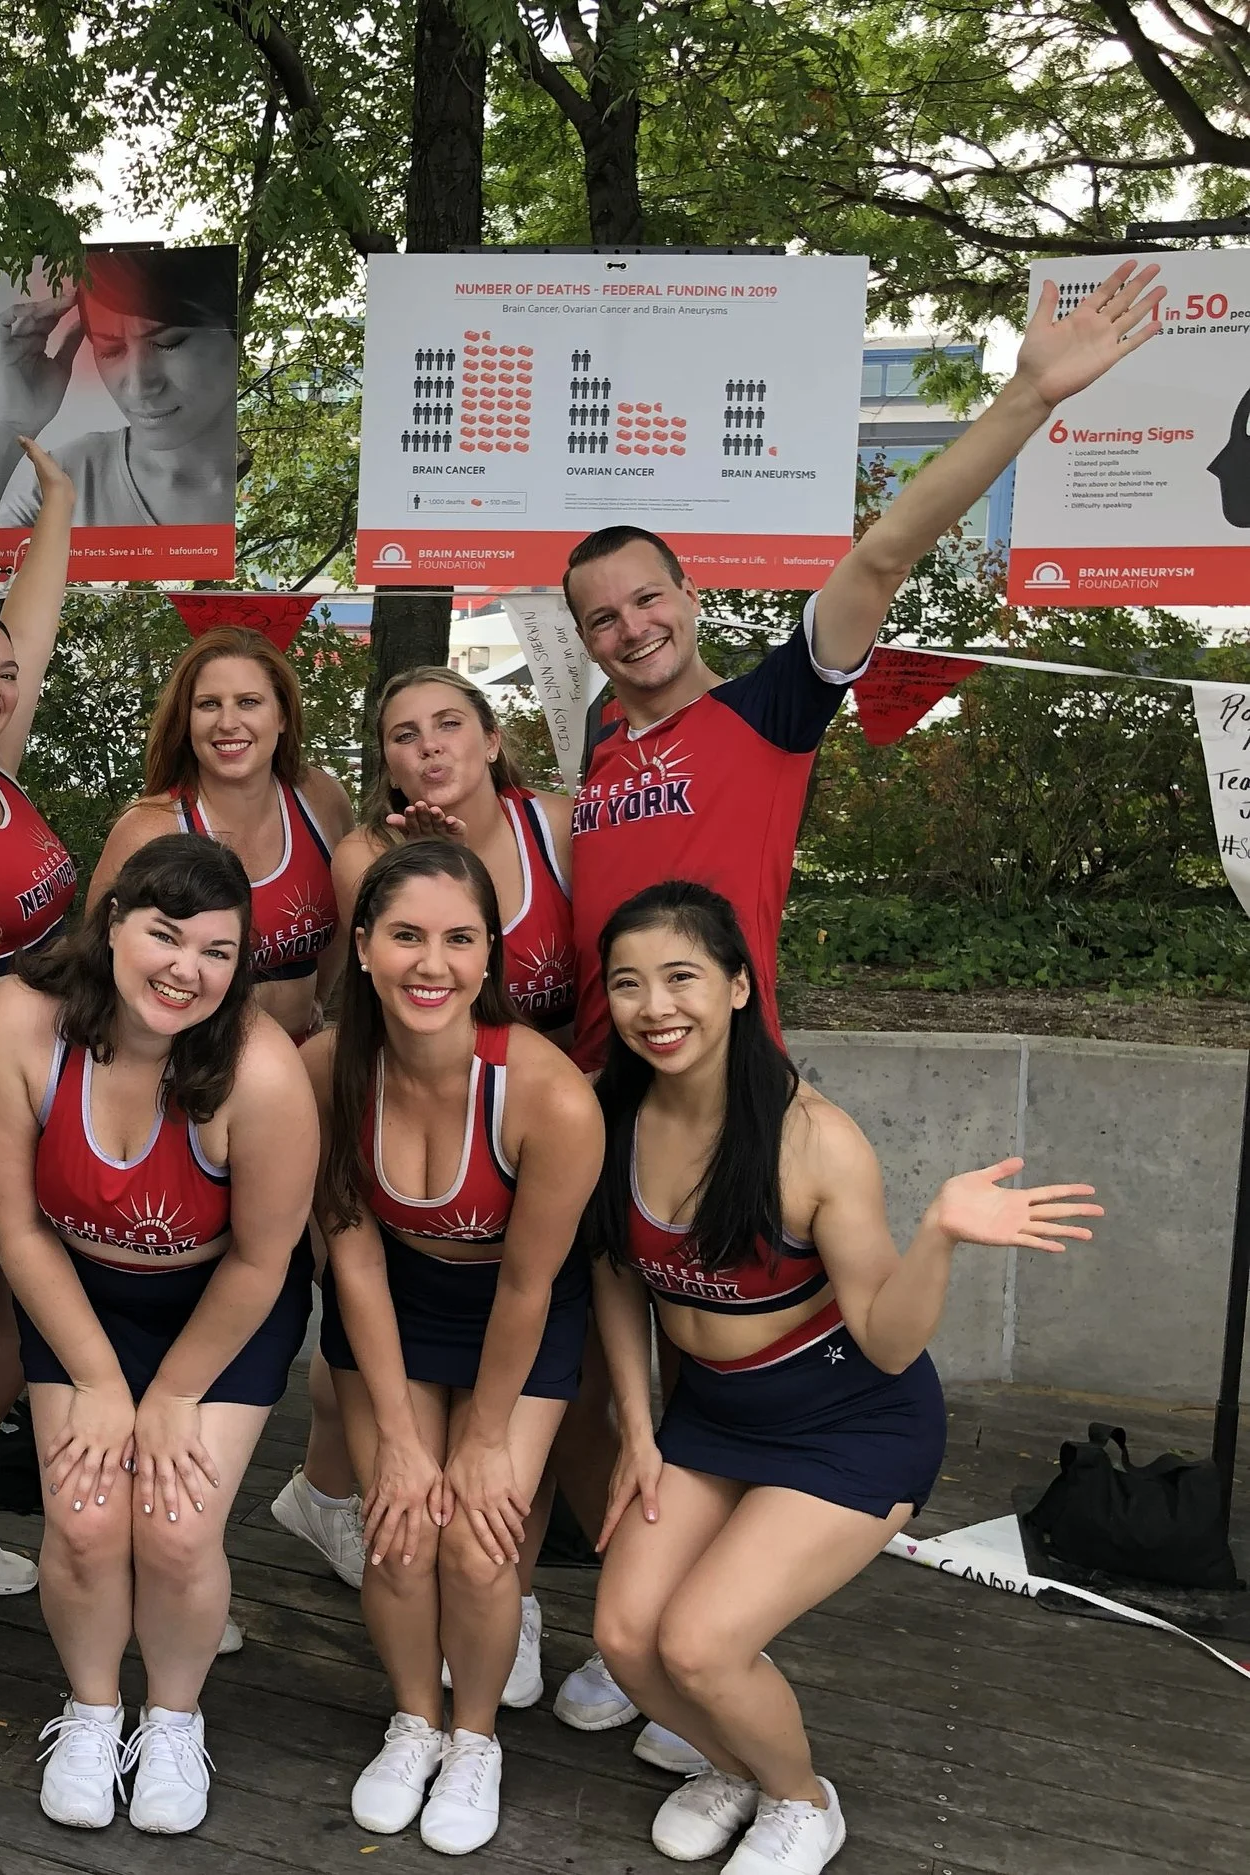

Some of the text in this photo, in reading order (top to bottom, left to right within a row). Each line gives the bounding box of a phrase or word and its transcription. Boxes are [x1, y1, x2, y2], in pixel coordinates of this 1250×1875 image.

[454, 283, 512, 295] NUMBER
[515, 283, 533, 295] OF
[536, 284, 591, 295] DEATHS
[602, 284, 663, 296] FEDERAL
[666, 285, 727, 297] FUNDING
[731, 285, 744, 297] IN
[748, 286, 778, 298] 2019
[502, 304, 728, 316] Brain Cancer, Ovarian Cancer and Brain Aneurysms
[1165, 307, 1181, 321] in
[1185, 293, 1229, 320] 50
[1167, 327, 1174, 335] a
[1177, 325, 1207, 335] brain
[1048, 419, 1195, 445] 6 Warning Signs
[1075, 448, 1139, 457] Localized headache
[412, 465, 486, 475] BRAIN CANCER
[1099, 460, 1120, 468] pupils
[566, 467, 655, 477] OVARIAN CANCER
[721, 469, 816, 480] BRAIN ANEURYSMS
[1107, 470, 1131, 478] double
[1118, 480, 1142, 488] behind
[1072, 491, 1104, 499] Weakness
[1071, 502, 1133, 510] Difficulty speaking
[70, 548, 83, 557] the
[84, 548, 108, 557] Facts.
[109, 547, 129, 557] Save
[136, 547, 155, 557] Life.
[169, 546, 218, 558] bafound.org
[418, 549, 515, 559] BRAIN ANEURYSM
[418, 560, 486, 570] FOUNDATION
[677, 555, 691, 564] the
[693, 555, 718, 564] Facts.
[719, 555, 740, 564] Save
[749, 556, 767, 565] Life.
[783, 556, 835, 568] bafound.org
[1078, 567, 1195, 578] BRAIN ANEURYSM
[1077, 579, 1159, 589] FOUNDATION
[554, 625, 569, 644] our
[520, 611, 571, 753] CINDY LYNN SHERWIN
[578, 771, 653, 801] CHEER
[571, 779, 695, 839] EW YORK
[31, 851, 62, 881] CHEER
[14, 875, 56, 922] NEW
[260, 918, 314, 948] HEER
[509, 975, 554, 993] EER
[64, 1215, 158, 1244] CHEER
[638, 1257, 705, 1282] CHEER
